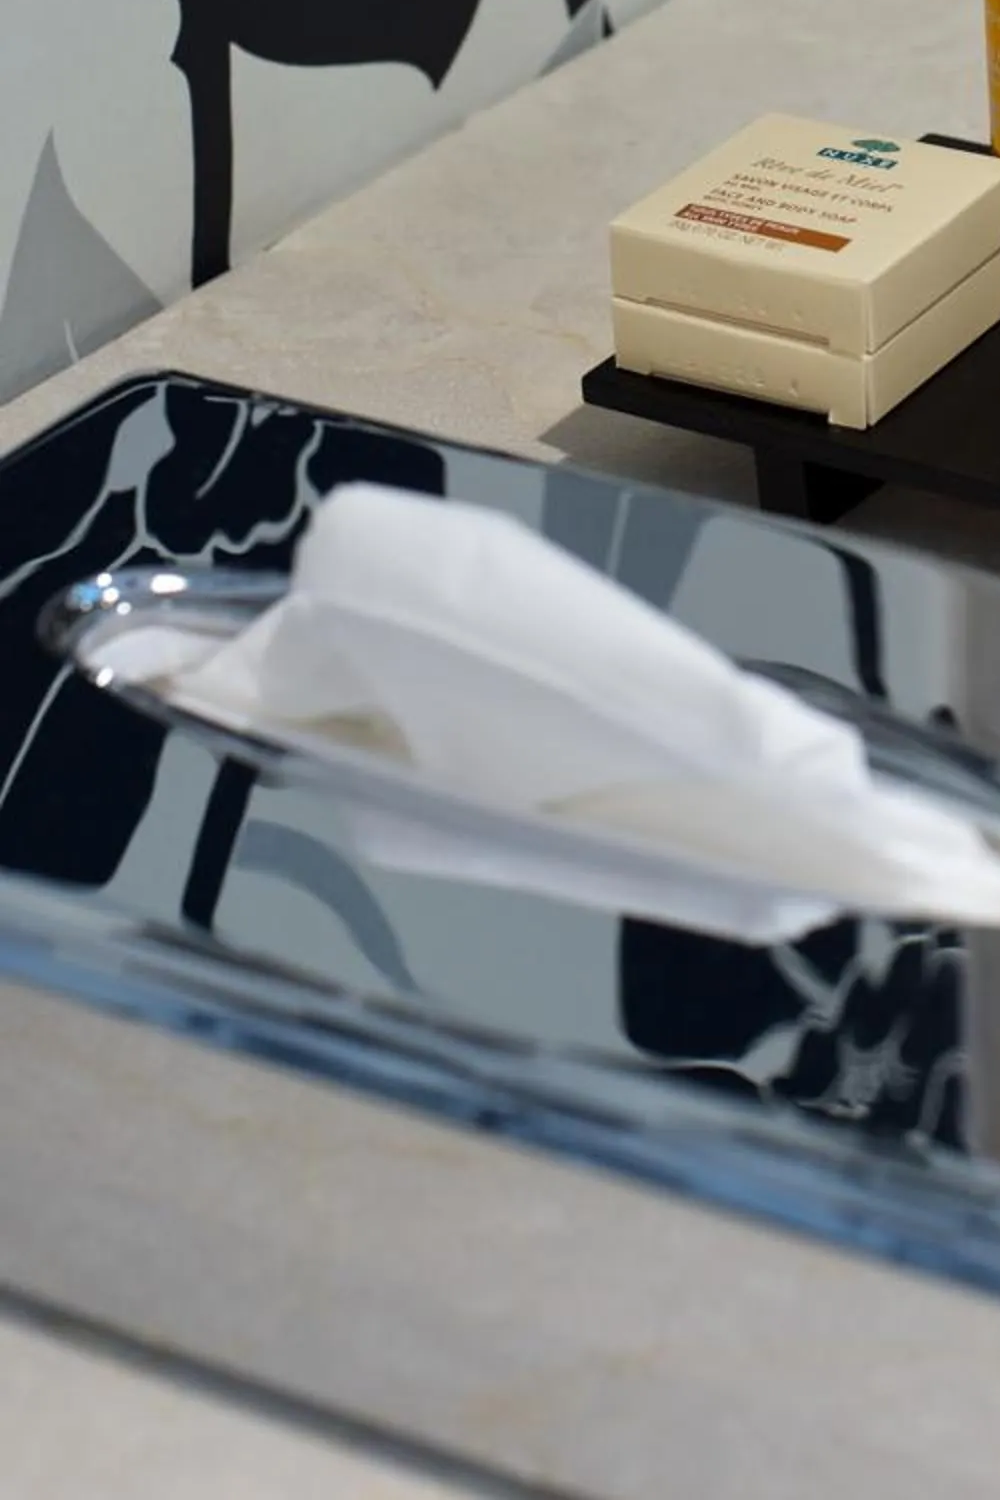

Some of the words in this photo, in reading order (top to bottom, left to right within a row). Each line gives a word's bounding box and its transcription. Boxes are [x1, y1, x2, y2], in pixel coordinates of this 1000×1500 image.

[820, 149, 895, 168] NUXE
[746, 196, 778, 208] AND
[779, 199, 817, 216] BODY
